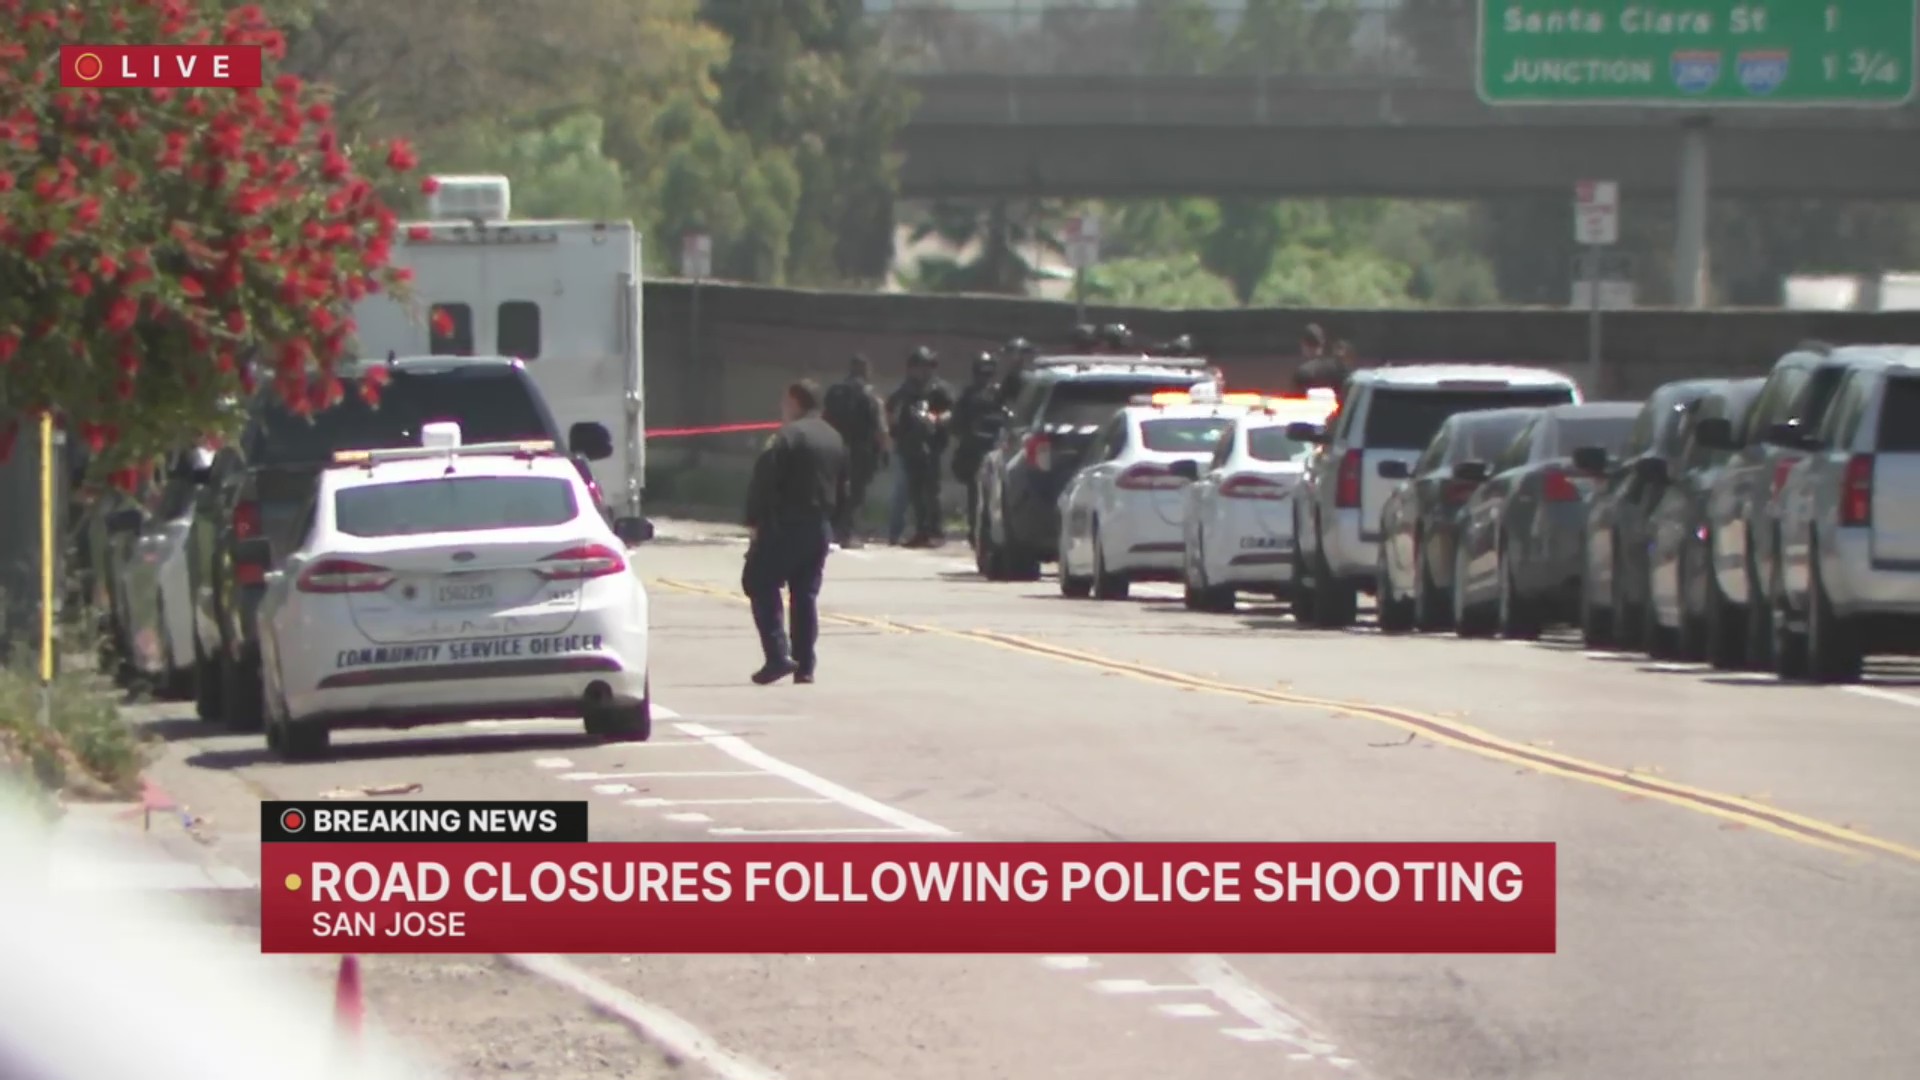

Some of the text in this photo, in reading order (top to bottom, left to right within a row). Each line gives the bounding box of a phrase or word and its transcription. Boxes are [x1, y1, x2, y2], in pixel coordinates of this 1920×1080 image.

[1503, 6, 1603, 34] Santa
[1620, 6, 1712, 34] Clara
[1729, 7, 1768, 34] St
[1503, 58, 1655, 84] JUNCTION
[336, 634, 604, 669] COMMUNITY SERVICE OFFICER
